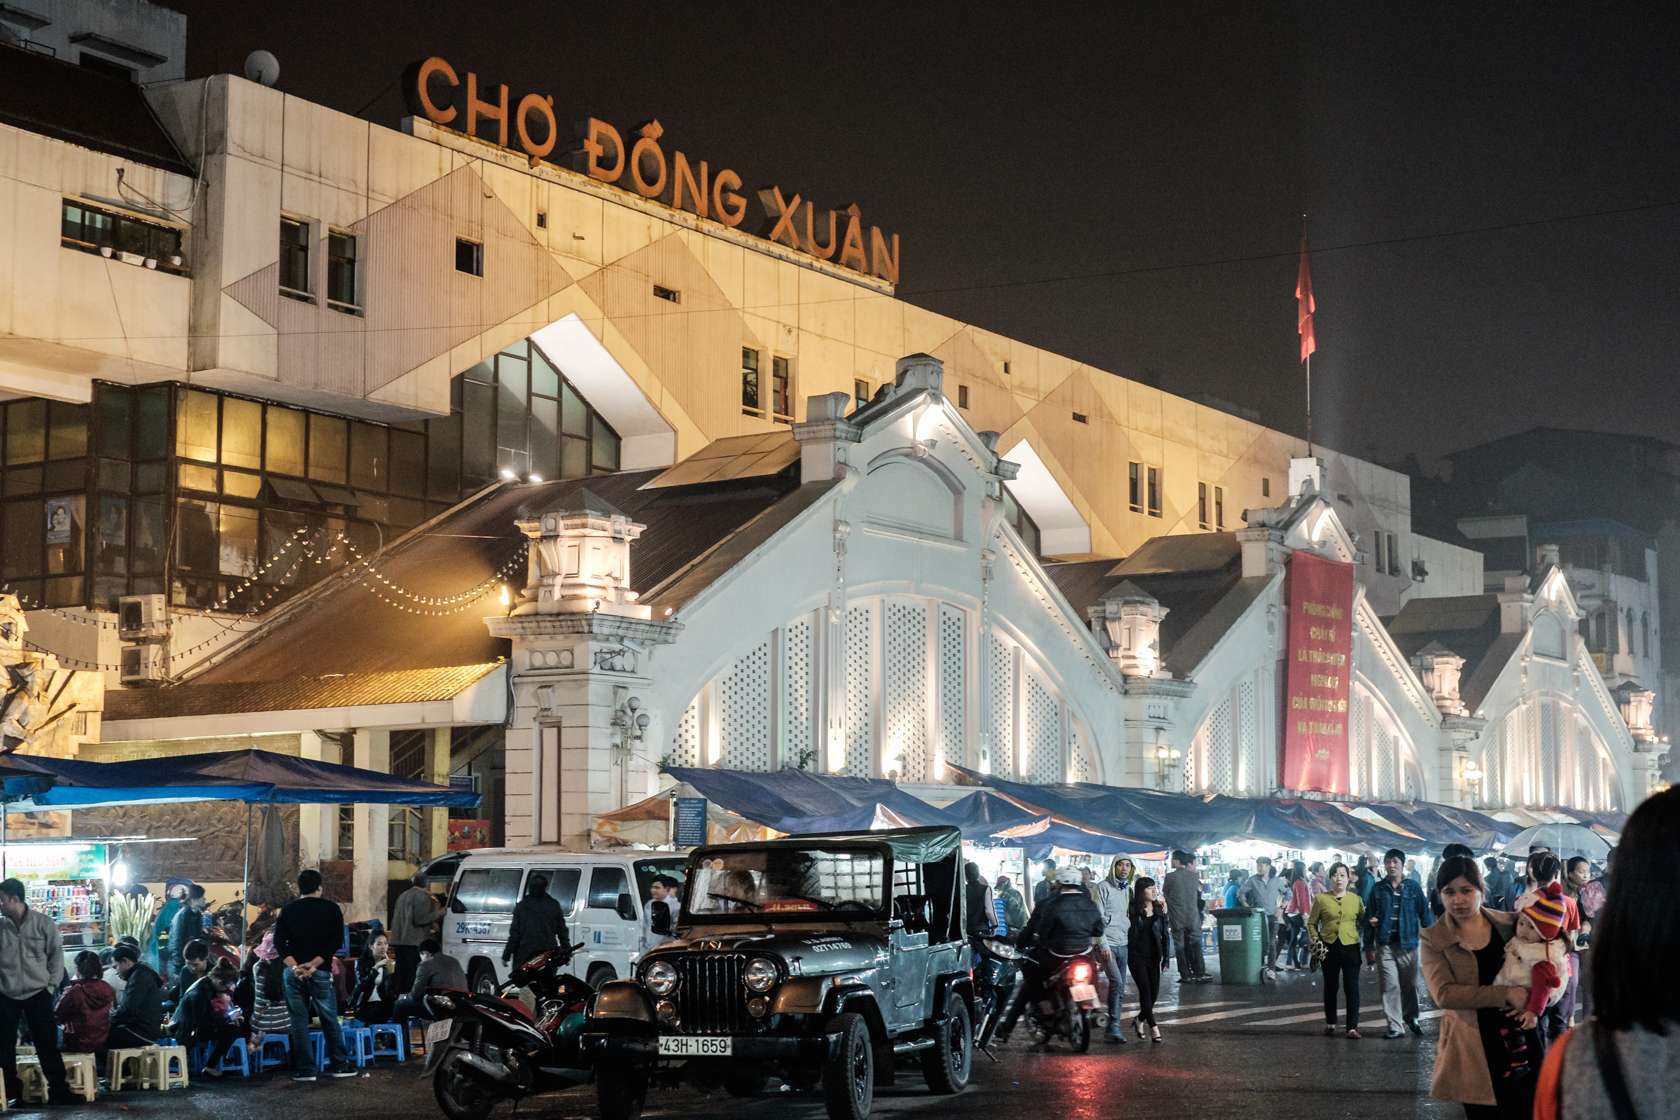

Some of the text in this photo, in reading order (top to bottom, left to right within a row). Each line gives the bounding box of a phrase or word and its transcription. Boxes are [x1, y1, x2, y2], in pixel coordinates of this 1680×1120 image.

[418, 56, 557, 167] CHỢ
[769, 185, 899, 284] XUÂN
[663, 1038, 727, 1053] 43H-1659
